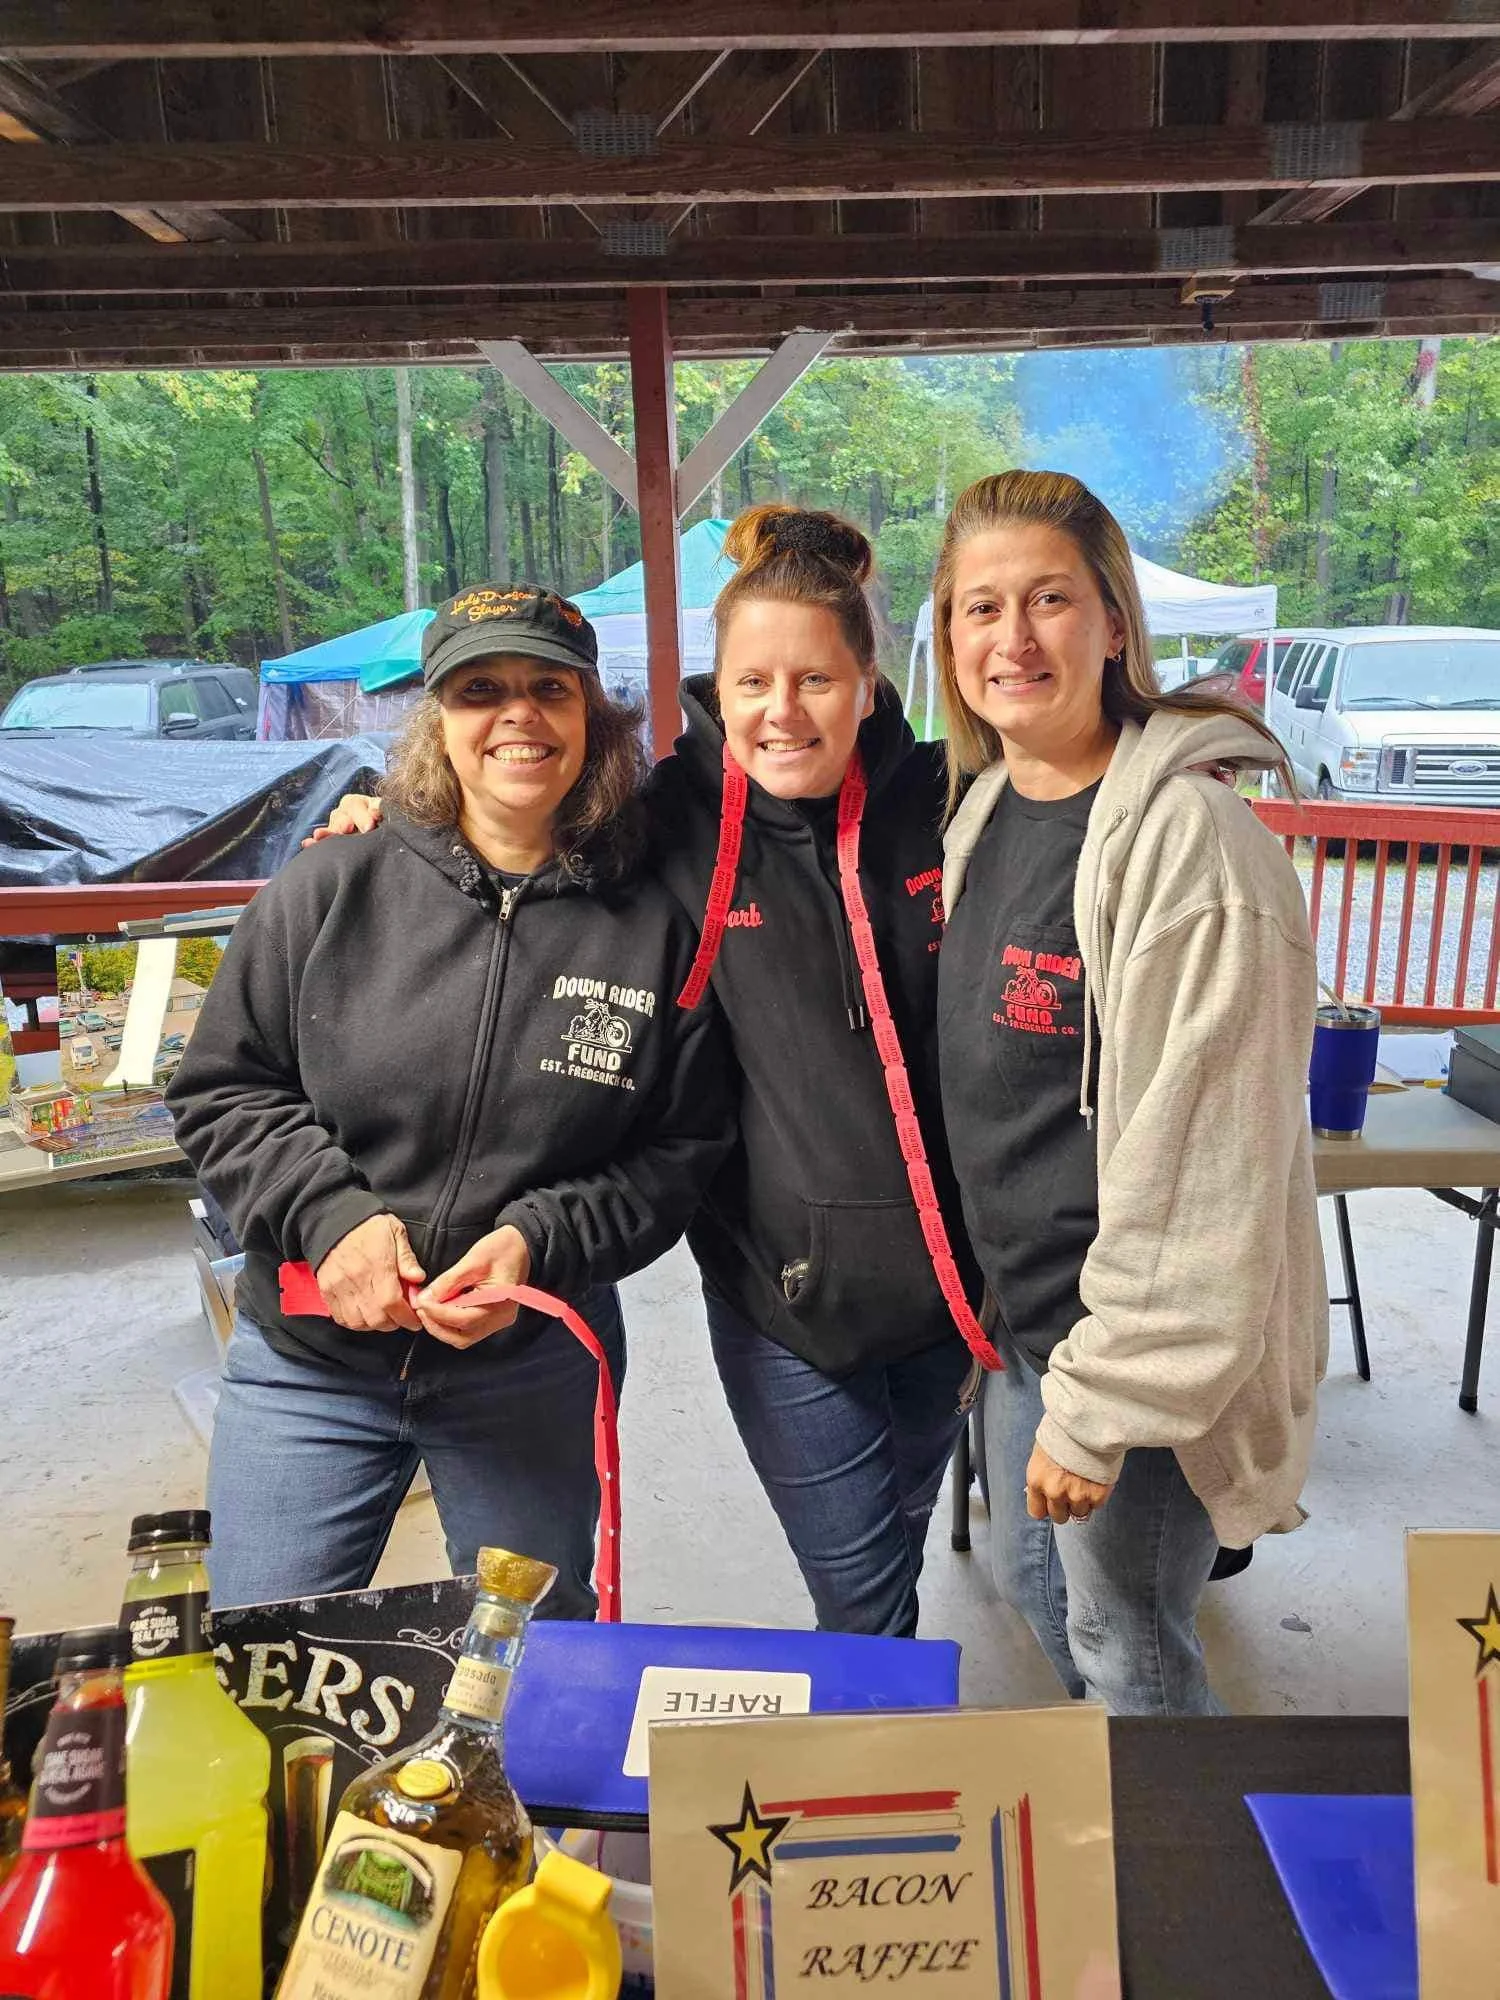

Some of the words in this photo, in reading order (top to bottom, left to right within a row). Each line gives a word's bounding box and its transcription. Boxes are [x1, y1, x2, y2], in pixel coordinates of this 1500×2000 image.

[450, 593, 479, 616] Lady
[468, 602, 516, 622] Slayer
[905, 867, 942, 897] DOWN
[724, 902, 763, 928] arb
[1035, 952, 1081, 981] RIDER
[552, 975, 607, 1000] DOWN
[608, 985, 656, 1018] RIDER
[1006, 1003, 1053, 1026] FUND
[567, 1043, 621, 1071] FUND
[540, 1058, 565, 1074] EST.
[567, 1063, 621, 1087] FREDERICK
[620, 1077, 636, 1091] CO.
[663, 1691, 782, 1714] RAFFLE
[805, 1871, 975, 1910] BACON
[310, 1903, 415, 1971] CENOTE
[798, 1939, 981, 1984] RAFFLE
